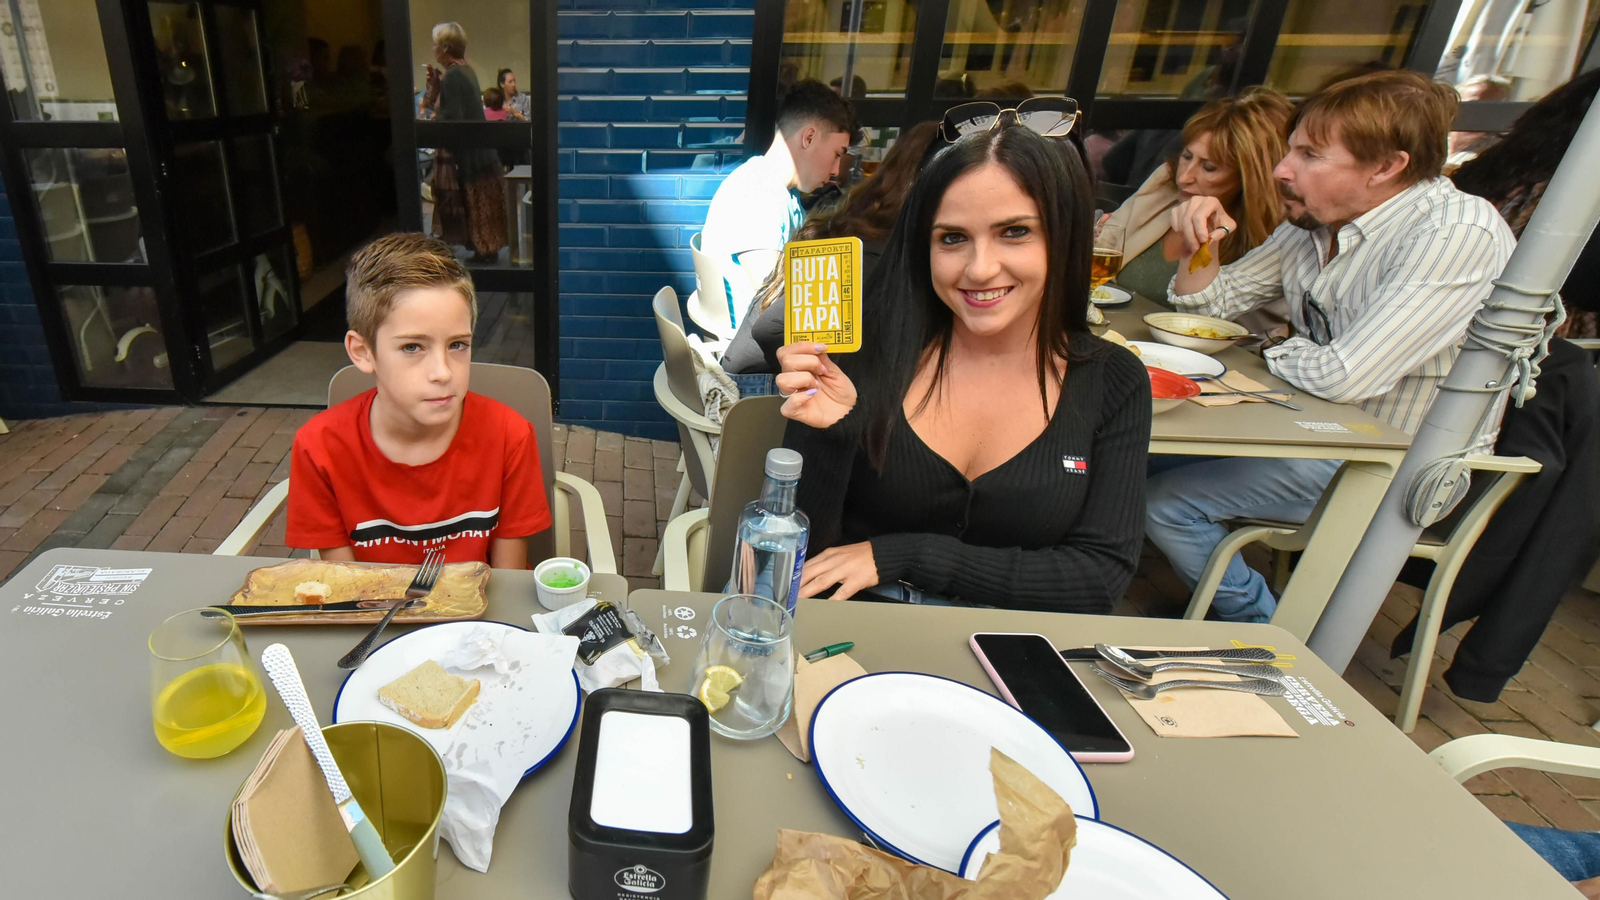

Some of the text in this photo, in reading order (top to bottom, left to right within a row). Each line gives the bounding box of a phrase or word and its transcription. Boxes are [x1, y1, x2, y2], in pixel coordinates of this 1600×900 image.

[800, 245, 850, 255] TAPAPORTE
[792, 255, 839, 282] RUTA
[792, 281, 840, 306] DE LA
[793, 306, 840, 331] TAPA
[423, 544, 446, 554] ITALIA
[120, 582, 140, 593] SIN
[23, 592, 125, 606] CERVEZA
[23, 605, 114, 620] Estrella Galicia
[1284, 675, 1341, 726] CERVEZA
[623, 871, 657, 882] Estrella
[623, 878, 655, 888] Galicia
